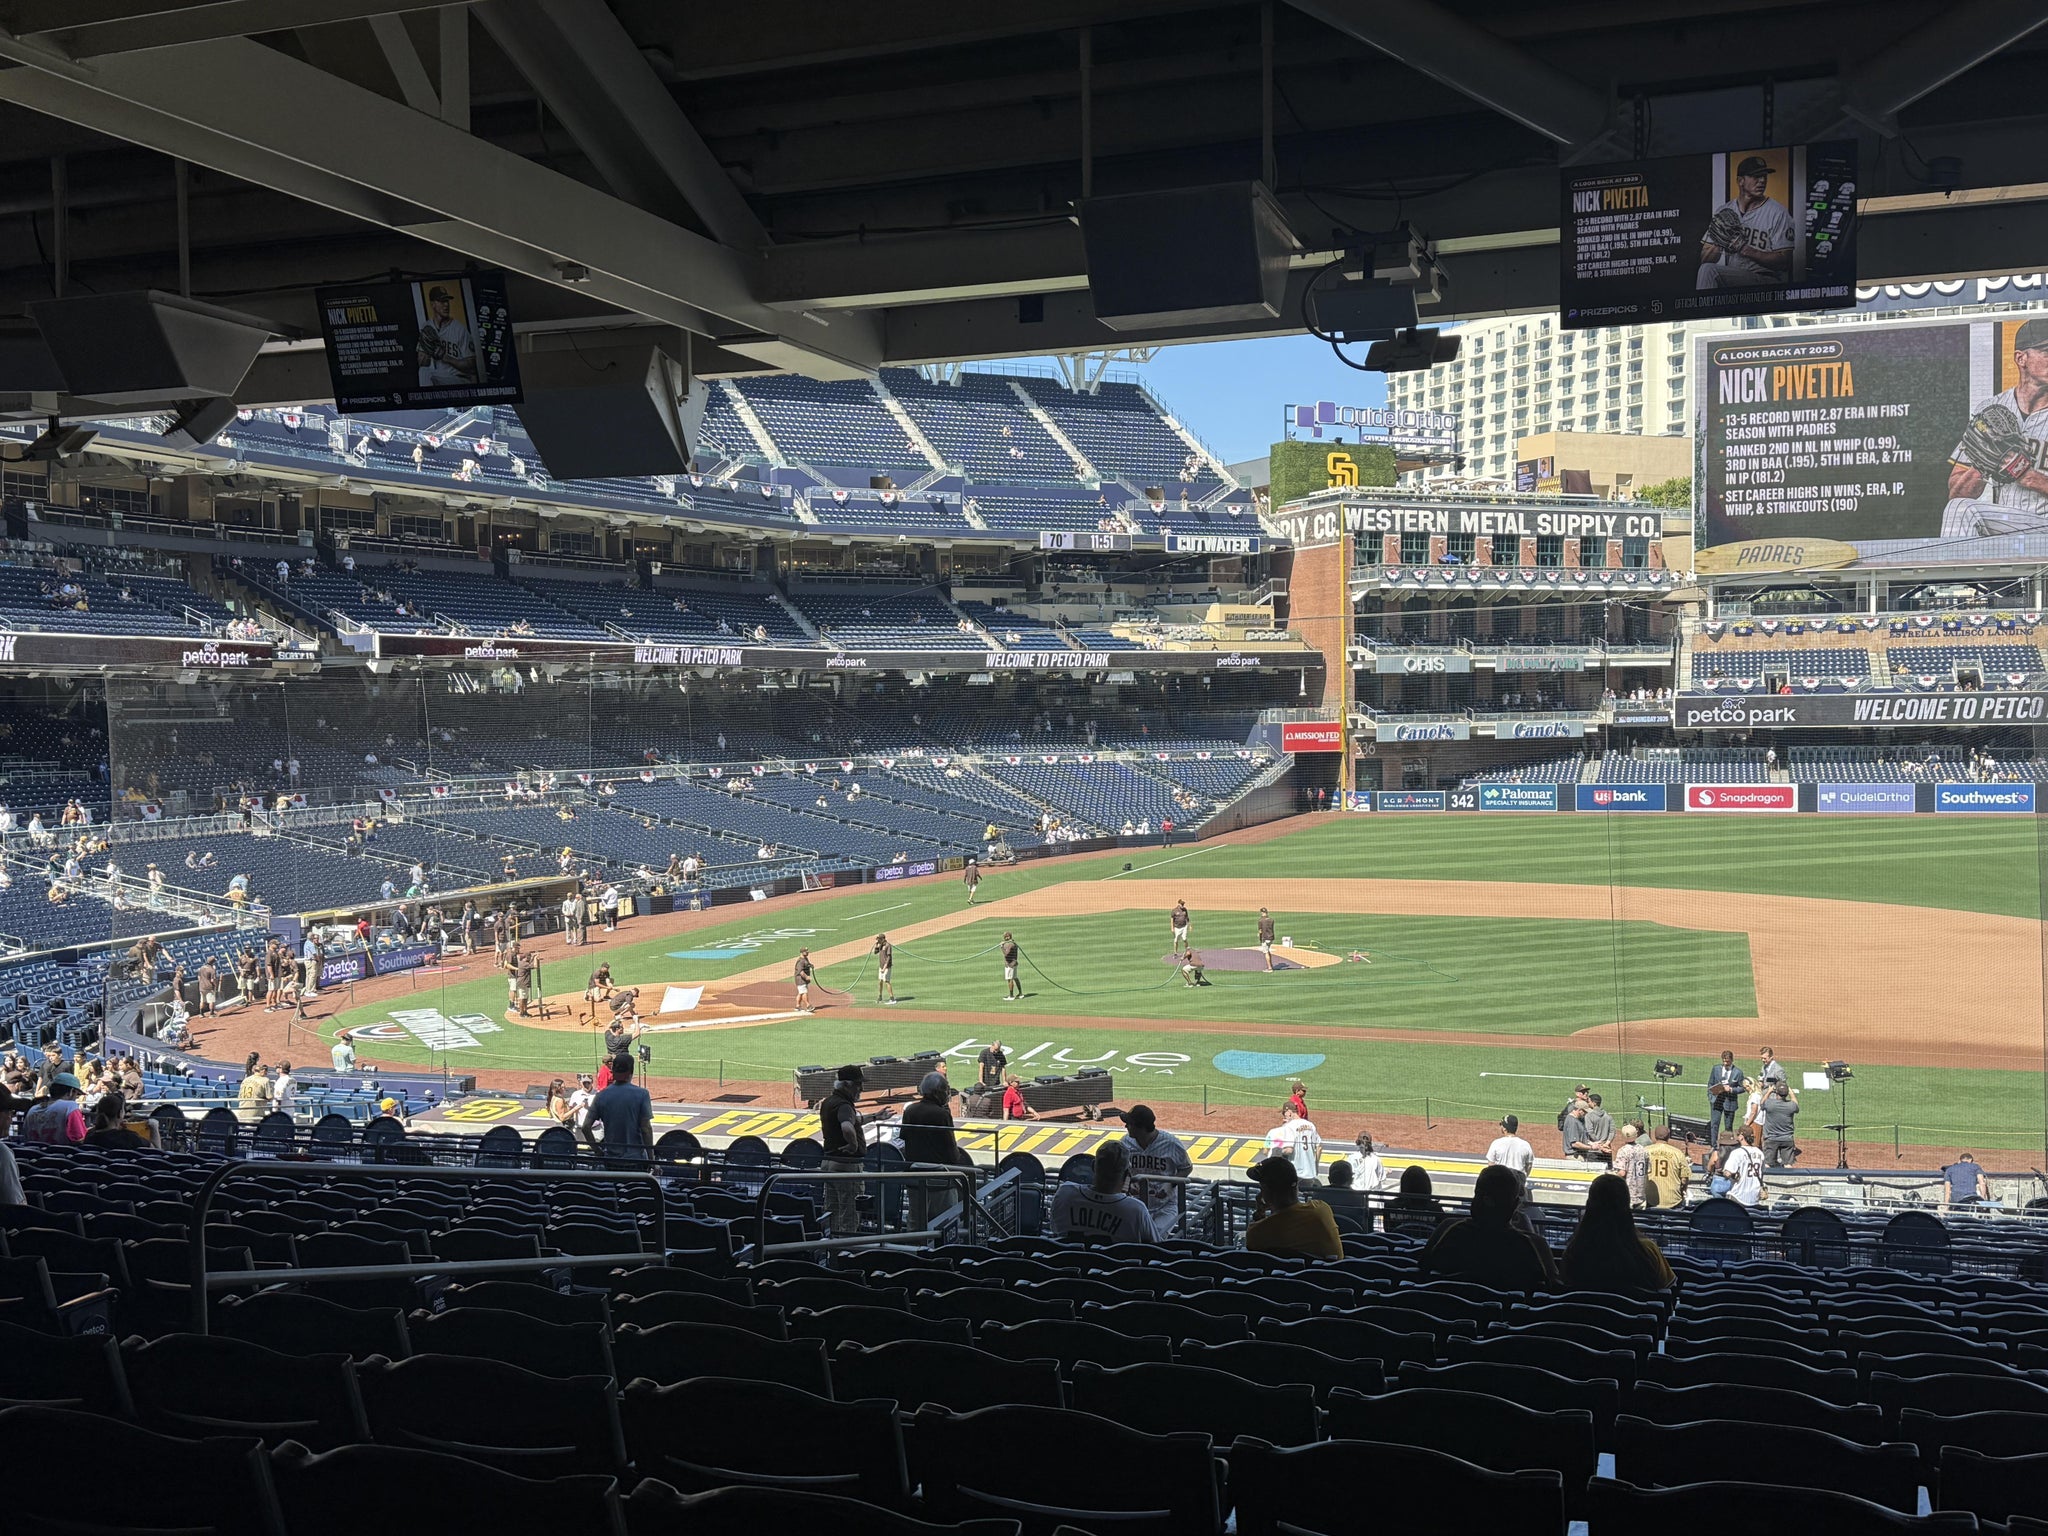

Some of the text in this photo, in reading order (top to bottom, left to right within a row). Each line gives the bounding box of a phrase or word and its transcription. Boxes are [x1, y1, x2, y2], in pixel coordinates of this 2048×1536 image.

[1573, 185, 1648, 213] NICK PIVETTA
[1577, 218, 1589, 226] 13-5
[1590, 216, 1613, 225] RECORD
[1613, 214, 1629, 222] WITH
[1643, 212, 1655, 220] ERA
[1663, 209, 1680, 218] FIRST
[1577, 221, 1639, 234] SEASON WITH PADRES
[1637, 230, 1653, 239] WHIP
[1670, 236, 1681, 244] 7TH
[1576, 263, 1587, 271] SET
[1599, 267, 1635, 277] STRIKEOUTS
[1785, 287, 1849, 300] SAN DIEGO PADRES
[346, 305, 378, 324] PIVETTA
[1580, 305, 1638, 316] PRIZEPICKS
[1730, 350, 1760, 360] LOOK
[1761, 348, 1791, 358] BACK
[1793, 347, 1807, 356] AT
[1809, 345, 1836, 355] 2025
[1719, 361, 1854, 404] NICK PIVETTA
[1340, 406, 1456, 431] QuidelOrtho
[1725, 404, 1910, 426] 13-5 RECORD WITH 2.87 ERA IN FIRST
[1725, 422, 1836, 440] SEASON WITH PADRES
[1726, 435, 1901, 458] RANKED 2ND IN NL IN WHIP (0.99),
[1725, 449, 1912, 472] 3RD IN BAA (.195), 5TH IN ERA, & 7TH
[1725, 469, 1786, 485] IN IP (181.2)
[1725, 481, 1905, 502] SET CAREER HIGHS IN WINS, ERA, IP,
[1725, 497, 1858, 517] WHIP, & STRIKEOUTS (190)
[1314, 511, 1340, 540] CO.
[1343, 507, 1660, 538] WESTERN METAL SUPPLY CO.
[1090, 534, 1114, 549] 11:51
[1177, 535, 1250, 553] CUTWATER
[1736, 544, 1804, 566] PADRES
[1889, 628, 2034, 638] ESTRELLA JALISCO LANDING
[182, 649, 249, 668] petco park
[464, 646, 519, 660] petco park
[634, 645, 743, 665] WELCOME TO PETCO PARK
[986, 653, 1109, 668] WELCOME TO PETCO PARK
[826, 656, 867, 668] petco park
[1216, 656, 1261, 667] petco park
[1403, 657, 1446, 672] ORIS
[1687, 706, 1796, 726] petco park
[1853, 696, 2045, 721] WELCOME TO PETCO
[1294, 731, 1340, 740] MISSION FED
[1451, 794, 1474, 808] 342
[1501, 788, 1553, 800] Palomar
[1595, 790, 1646, 802] us bank
[1719, 792, 1784, 804] Snapdragon
[1840, 792, 1911, 803] QuidelOrtho
[1941, 791, 2018, 804] Southwest
[884, 866, 904, 879] petco
[916, 862, 935, 875] petco
[328, 959, 358, 979] petco
[379, 951, 426, 971] Southwest
[940, 1038, 1192, 1067] blue
[957, 1122, 1266, 1168] FAITUL
[1301, 1135, 1308, 1151] 3
[1131, 1154, 1167, 1171] ADRES
[1634, 1161, 1645, 1177] 13
[1654, 1159, 1669, 1177] 13
[1070, 1207, 1122, 1235] LOLICH
